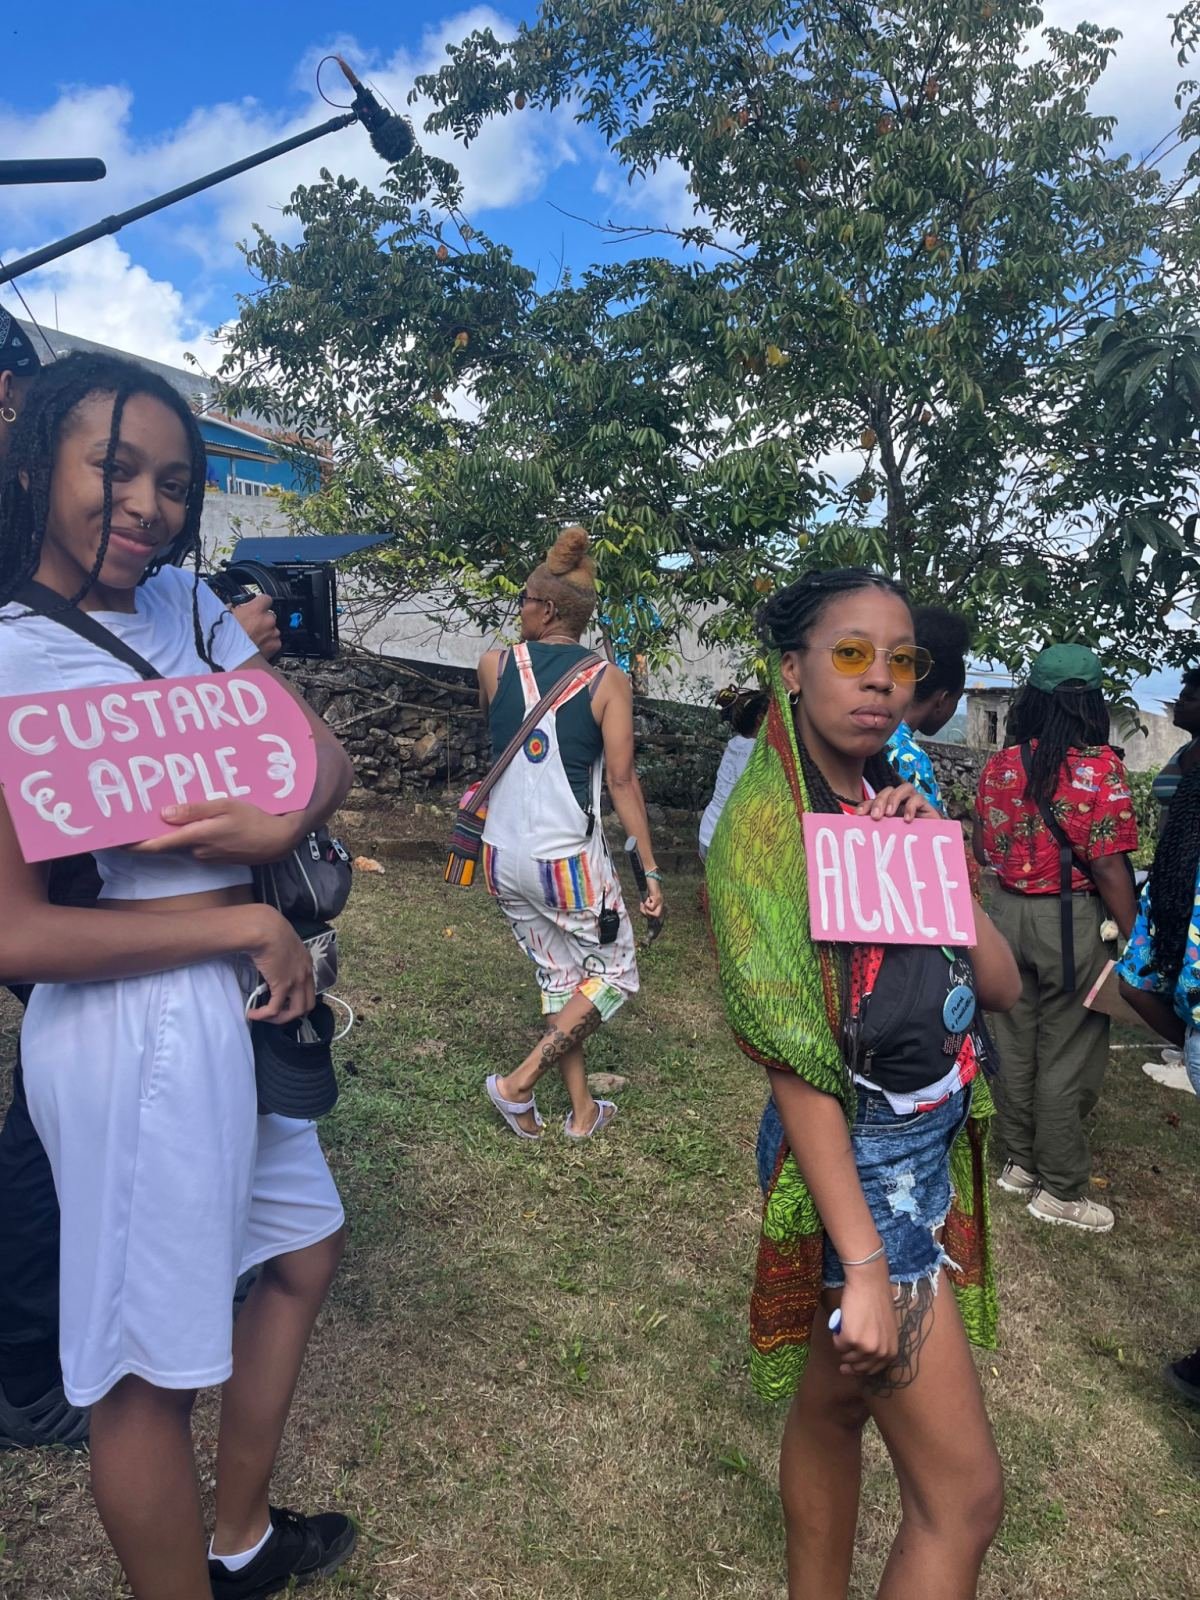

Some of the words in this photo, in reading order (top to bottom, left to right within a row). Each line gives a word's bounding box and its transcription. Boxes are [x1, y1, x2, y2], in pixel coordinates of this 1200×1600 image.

[8, 679, 267, 756] CUSTARD
[88, 746, 250, 818] APPLE
[815, 827, 968, 941] ACKEE
